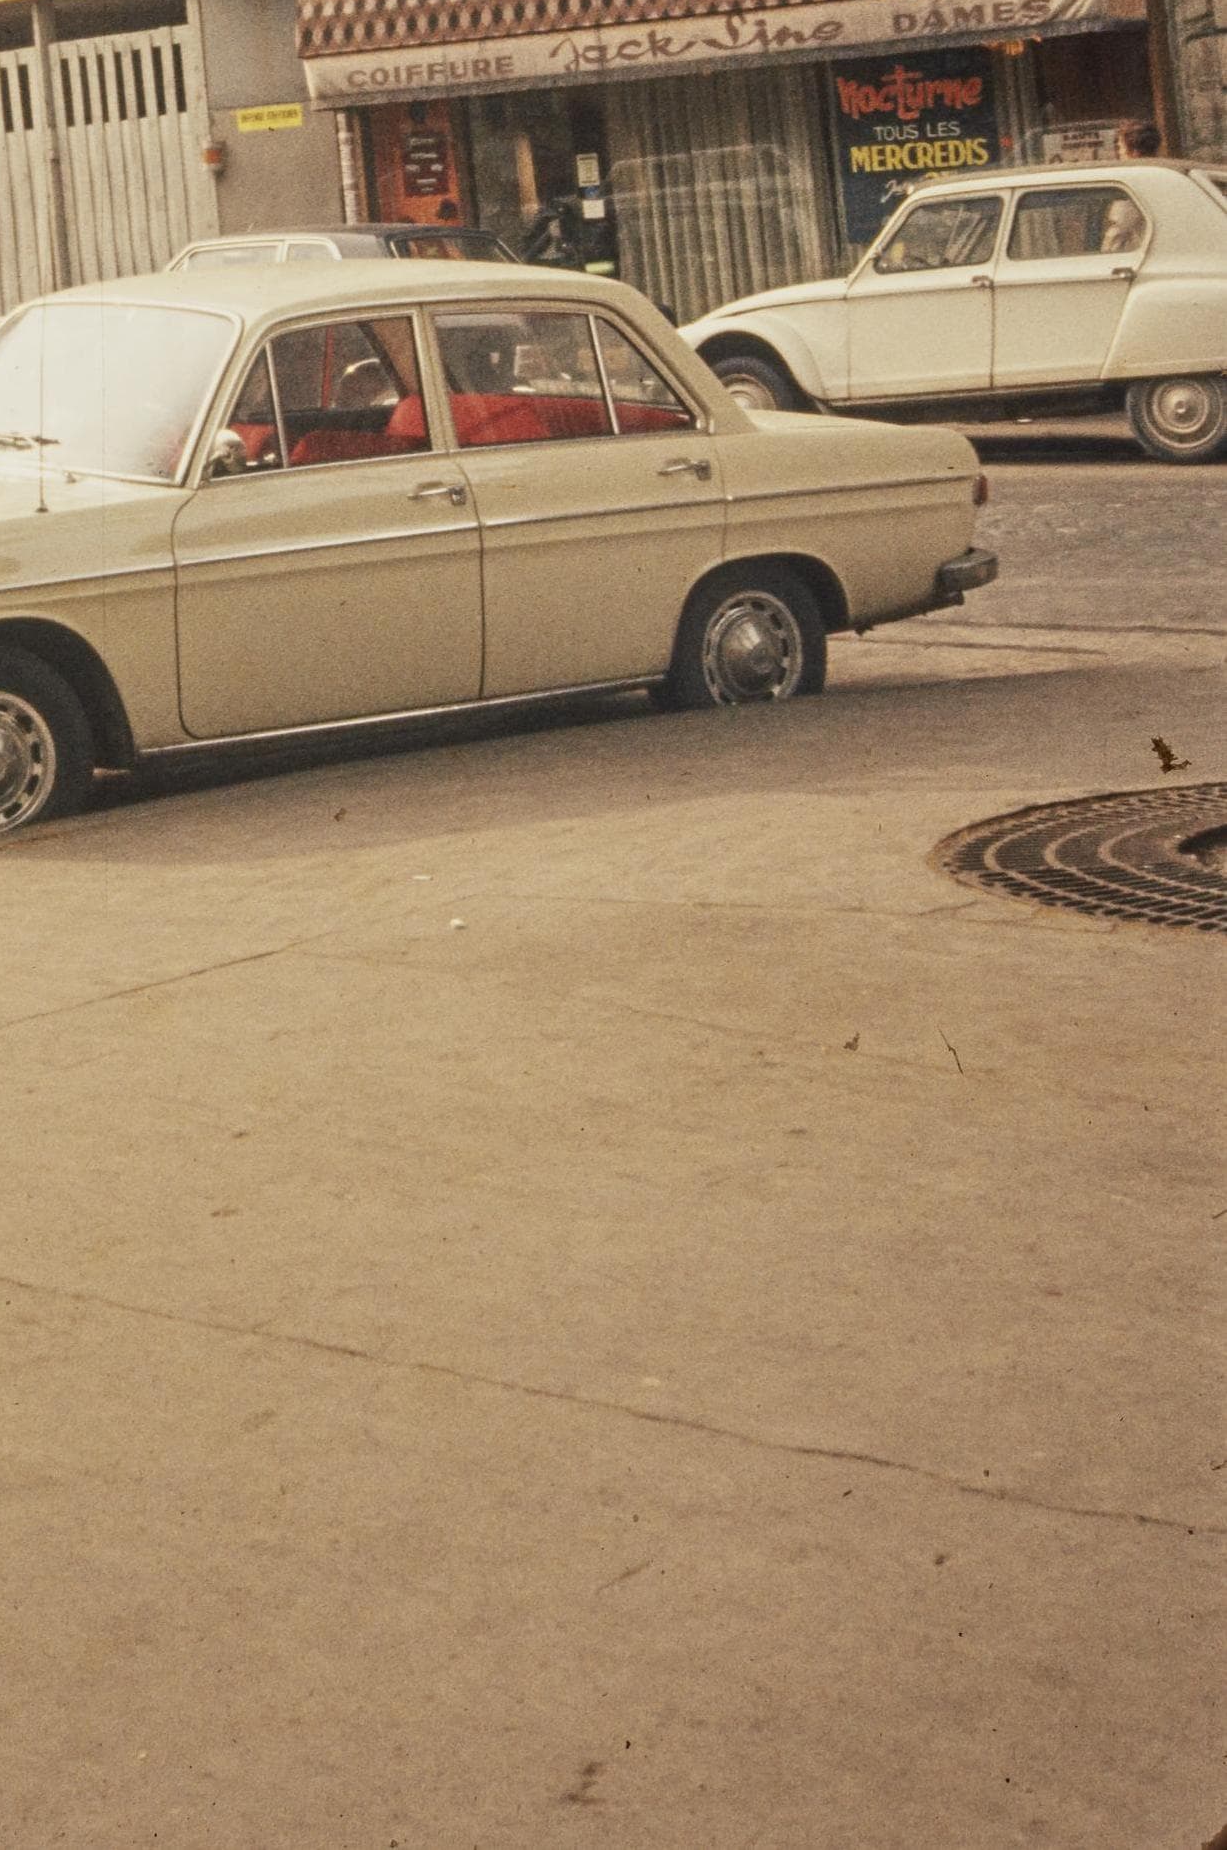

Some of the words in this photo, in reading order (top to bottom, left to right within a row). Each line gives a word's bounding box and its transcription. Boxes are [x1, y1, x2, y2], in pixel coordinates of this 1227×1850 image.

[346, 52, 515, 90] COIFFURE
[874, 124, 919, 141] TOUS
[926, 121, 961, 137] LES
[849, 138, 990, 173] MERCREDIS
